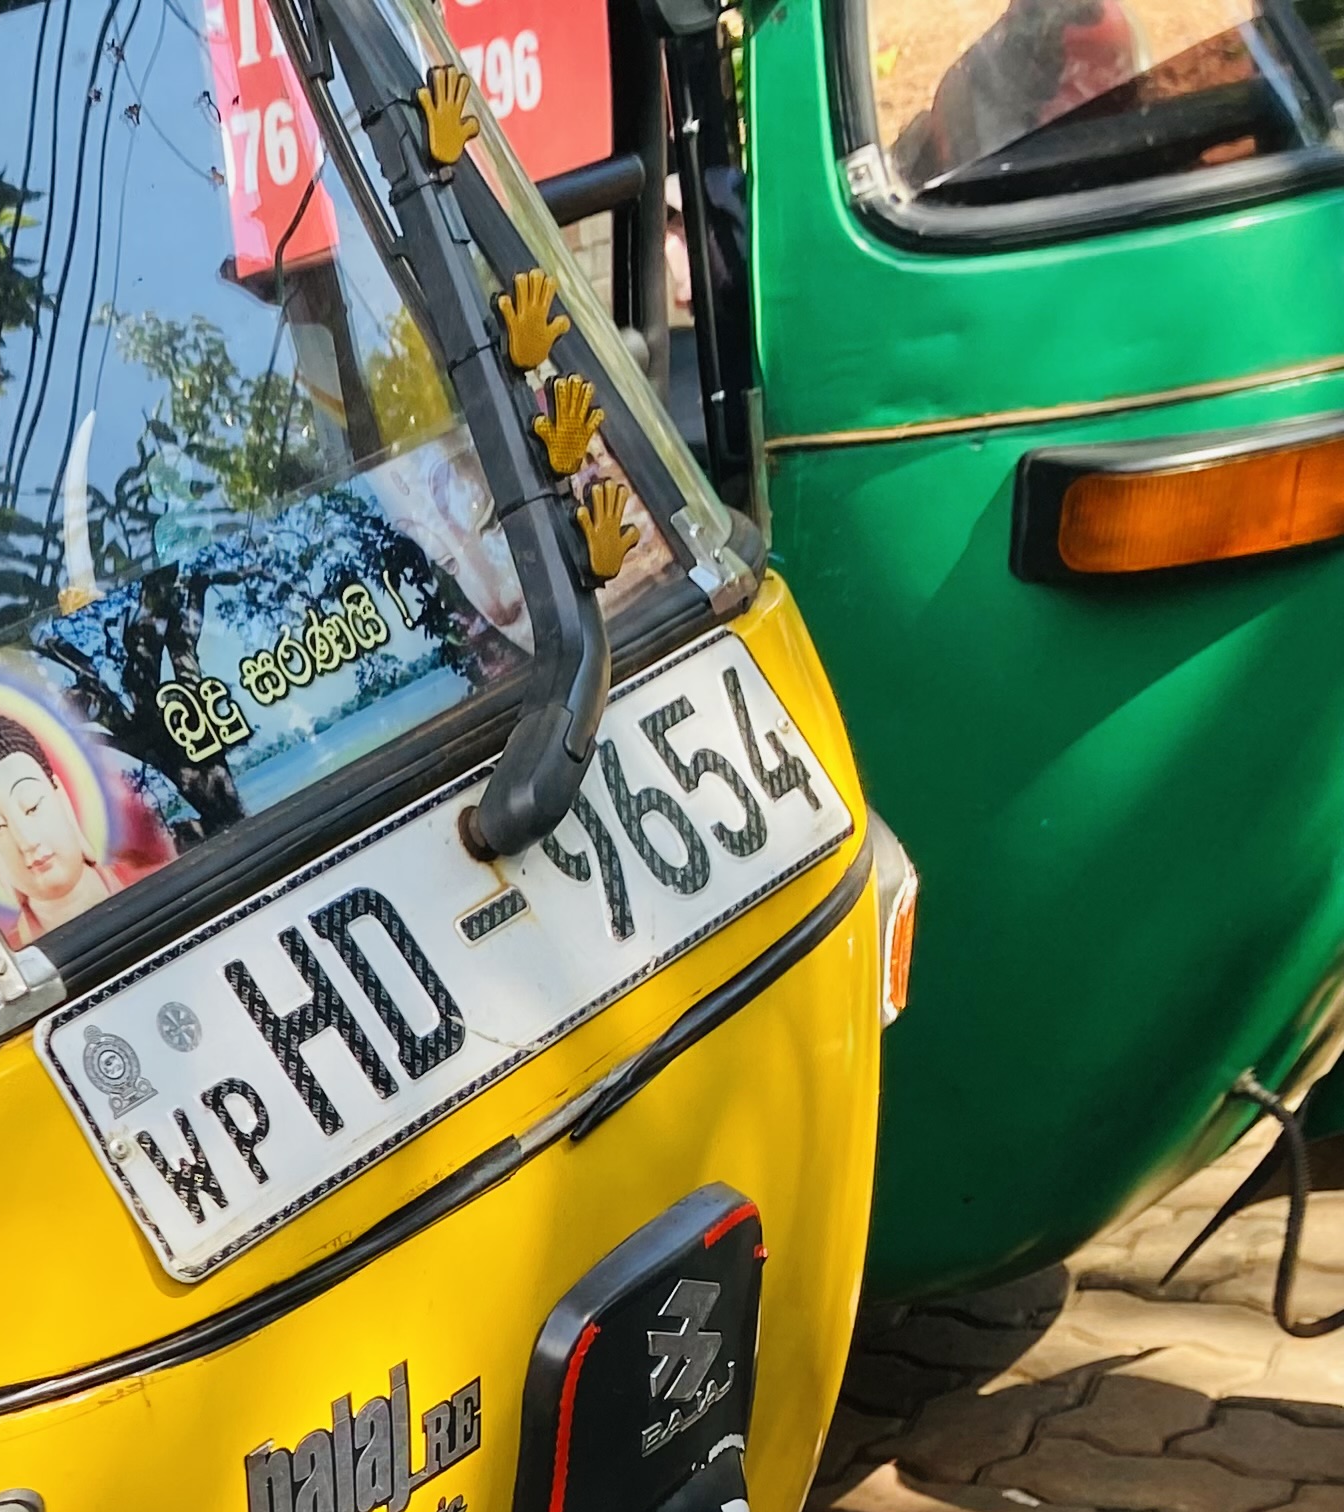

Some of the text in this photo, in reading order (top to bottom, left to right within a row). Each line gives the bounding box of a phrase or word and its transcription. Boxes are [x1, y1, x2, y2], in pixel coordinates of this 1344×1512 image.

[221, 99, 298, 198] 76
[134, 1075, 272, 1224] WP
[421, 1376, 482, 1476] RE
